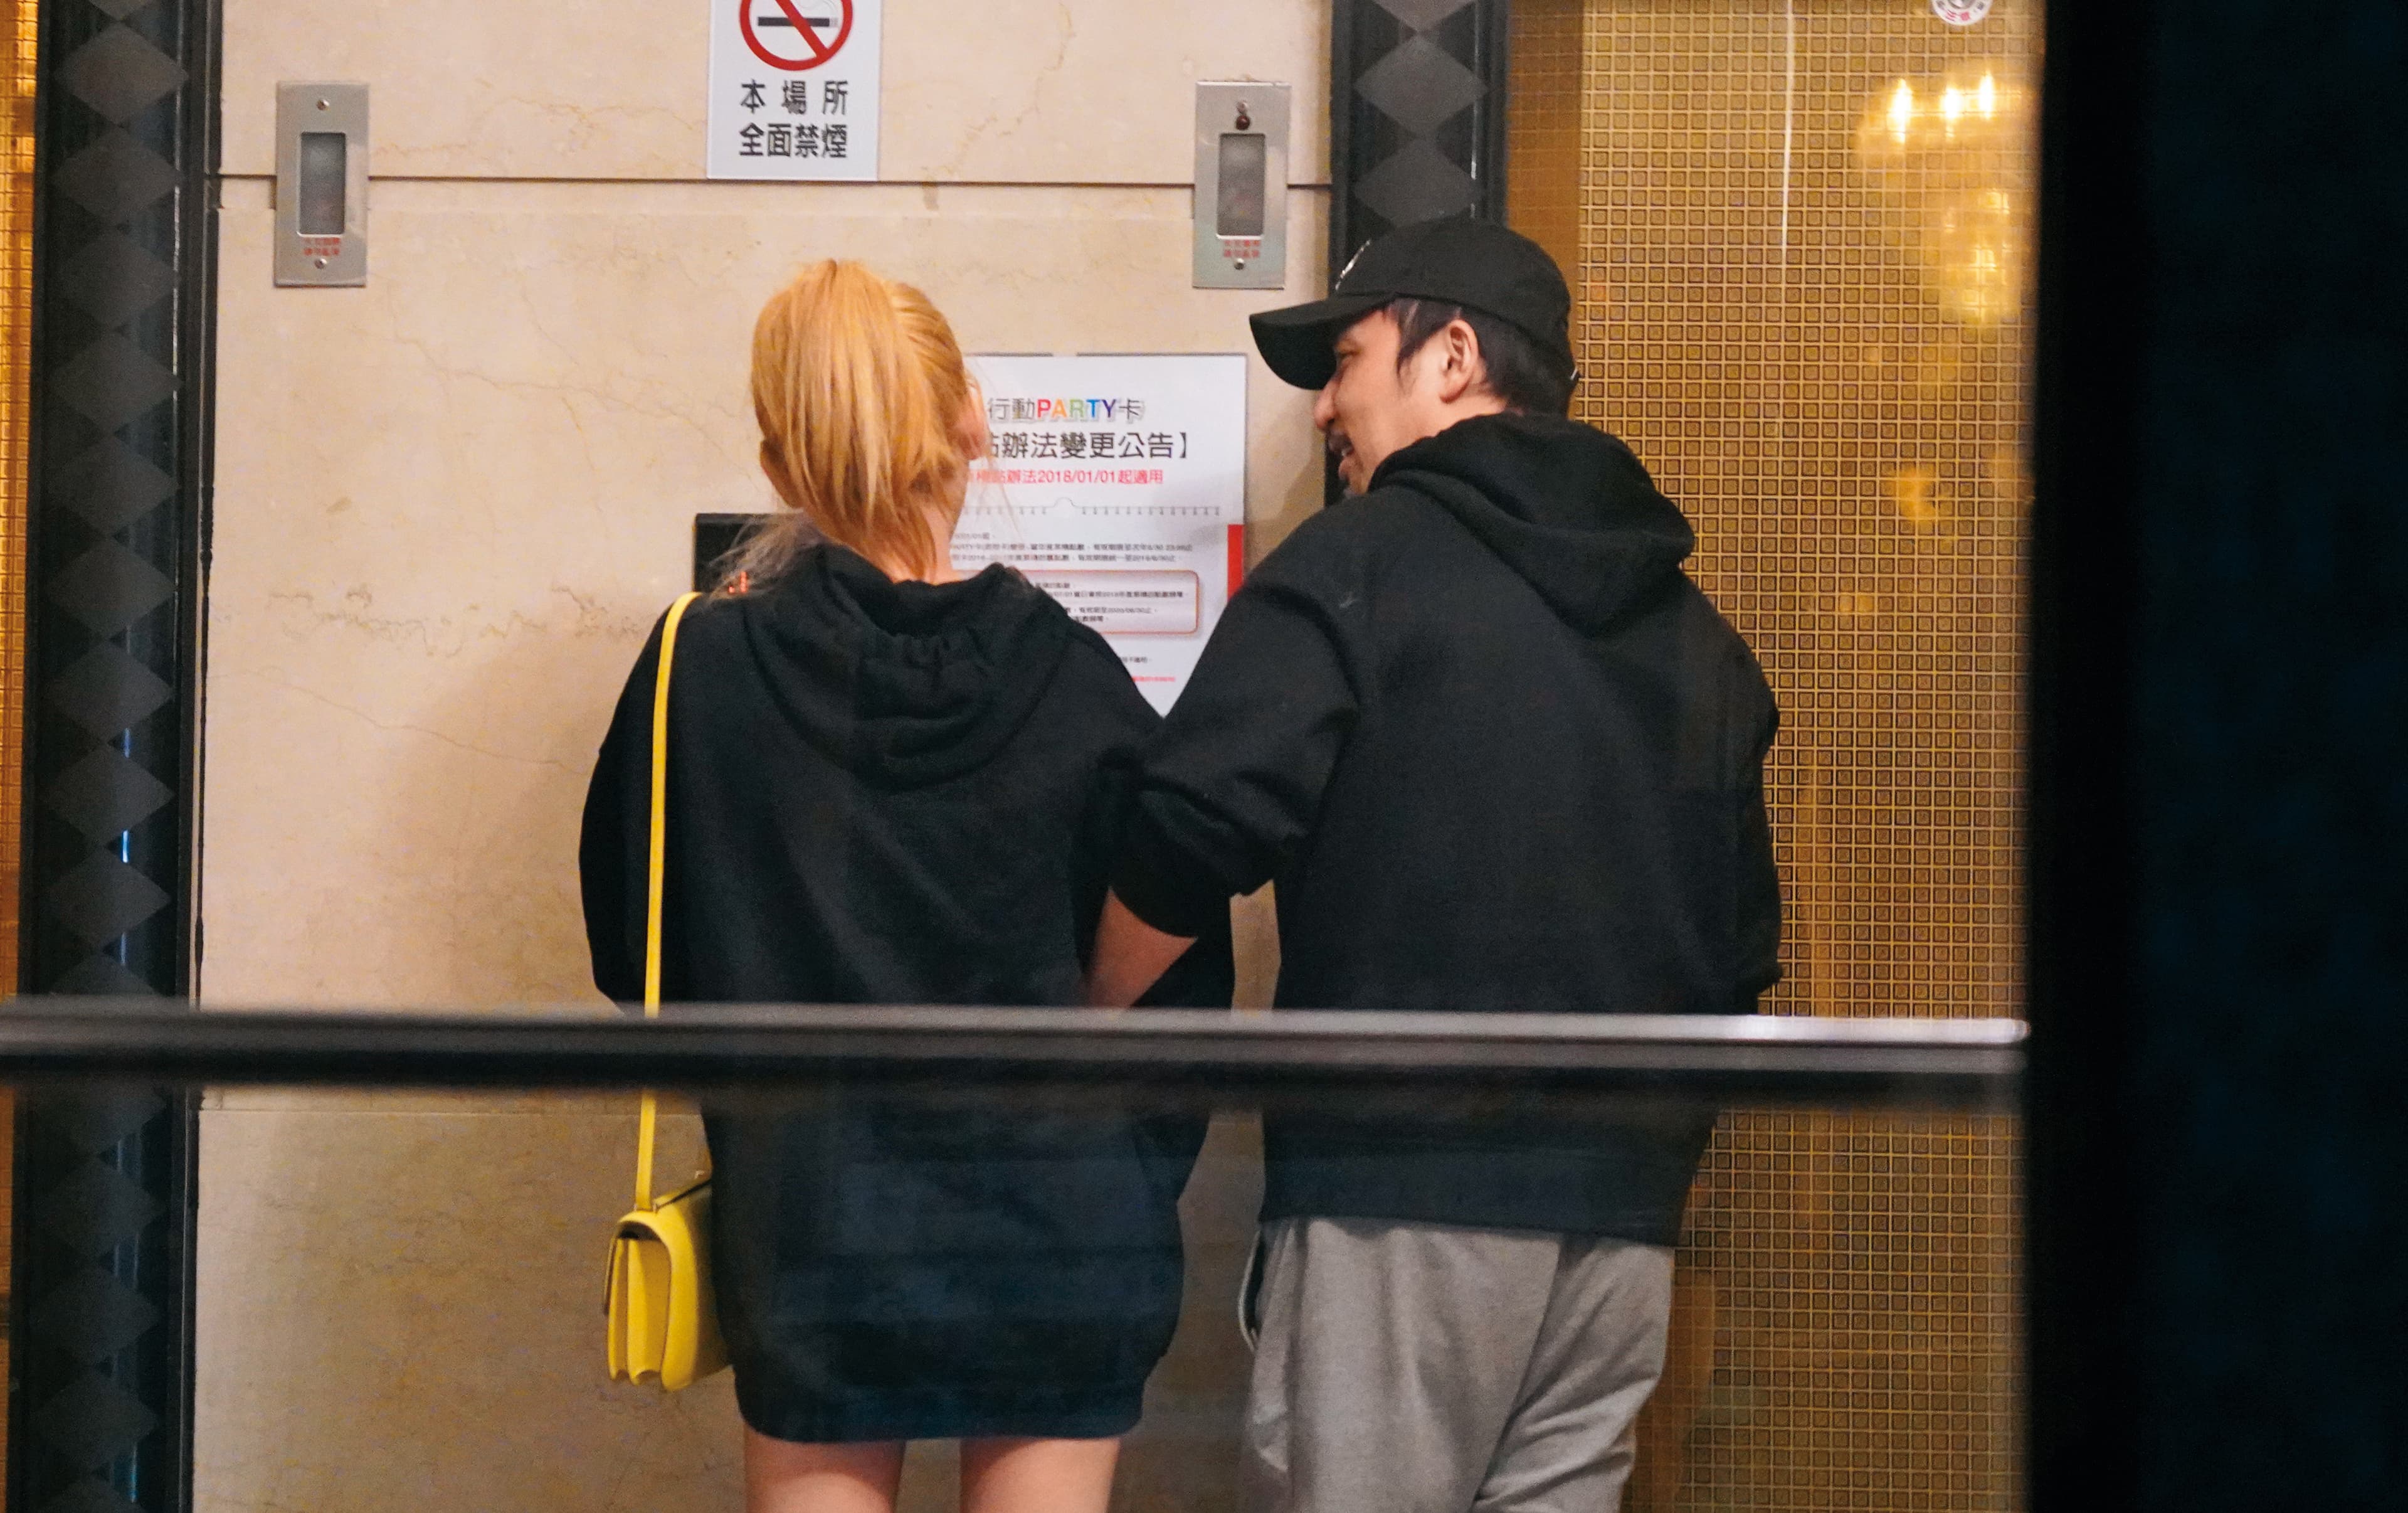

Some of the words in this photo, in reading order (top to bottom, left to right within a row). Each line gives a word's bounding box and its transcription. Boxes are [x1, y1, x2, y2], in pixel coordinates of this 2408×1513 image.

[739, 78, 848, 115] 本場所
[739, 122, 847, 159] 全面禁煙
[987, 398, 1143, 422] 行動PARTY卡
